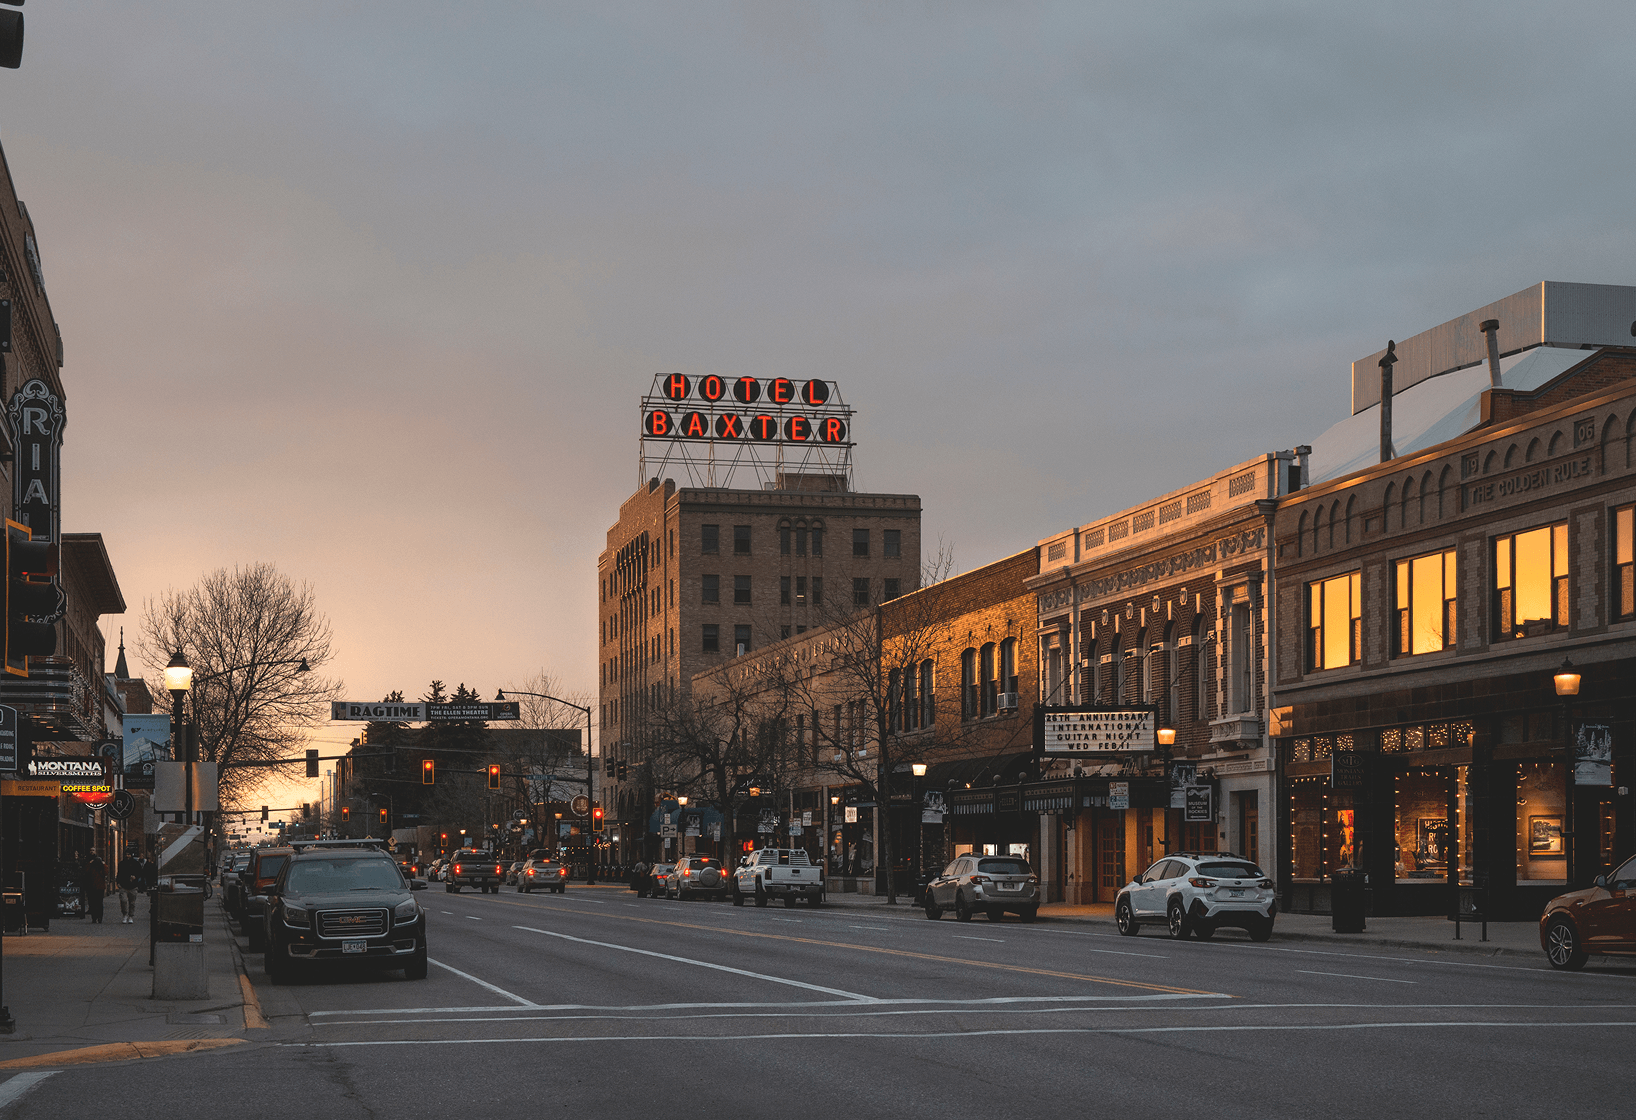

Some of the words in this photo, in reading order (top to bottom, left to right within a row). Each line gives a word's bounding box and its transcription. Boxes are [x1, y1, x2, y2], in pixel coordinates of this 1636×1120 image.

[670, 374, 824, 405] HOTEL
[652, 411, 841, 442] BAXTER
[1578, 424, 1594, 442] 06
[1466, 458, 1478, 475] 19
[1471, 483, 1494, 504] THE
[1497, 468, 1549, 497] GOLDEN
[350, 705, 421, 717] RAGTIME
[1046, 714, 1070, 722] 26TH
[1079, 713, 1149, 721] ANNIVERSARY
[1052, 723, 1148, 731] INTERNATIONAL
[1057, 733, 1097, 741] GUITAR
[1105, 732, 1141, 740] NIGHT
[38, 761, 102, 771] MONTANA
[663, 826, 670, 835] P
